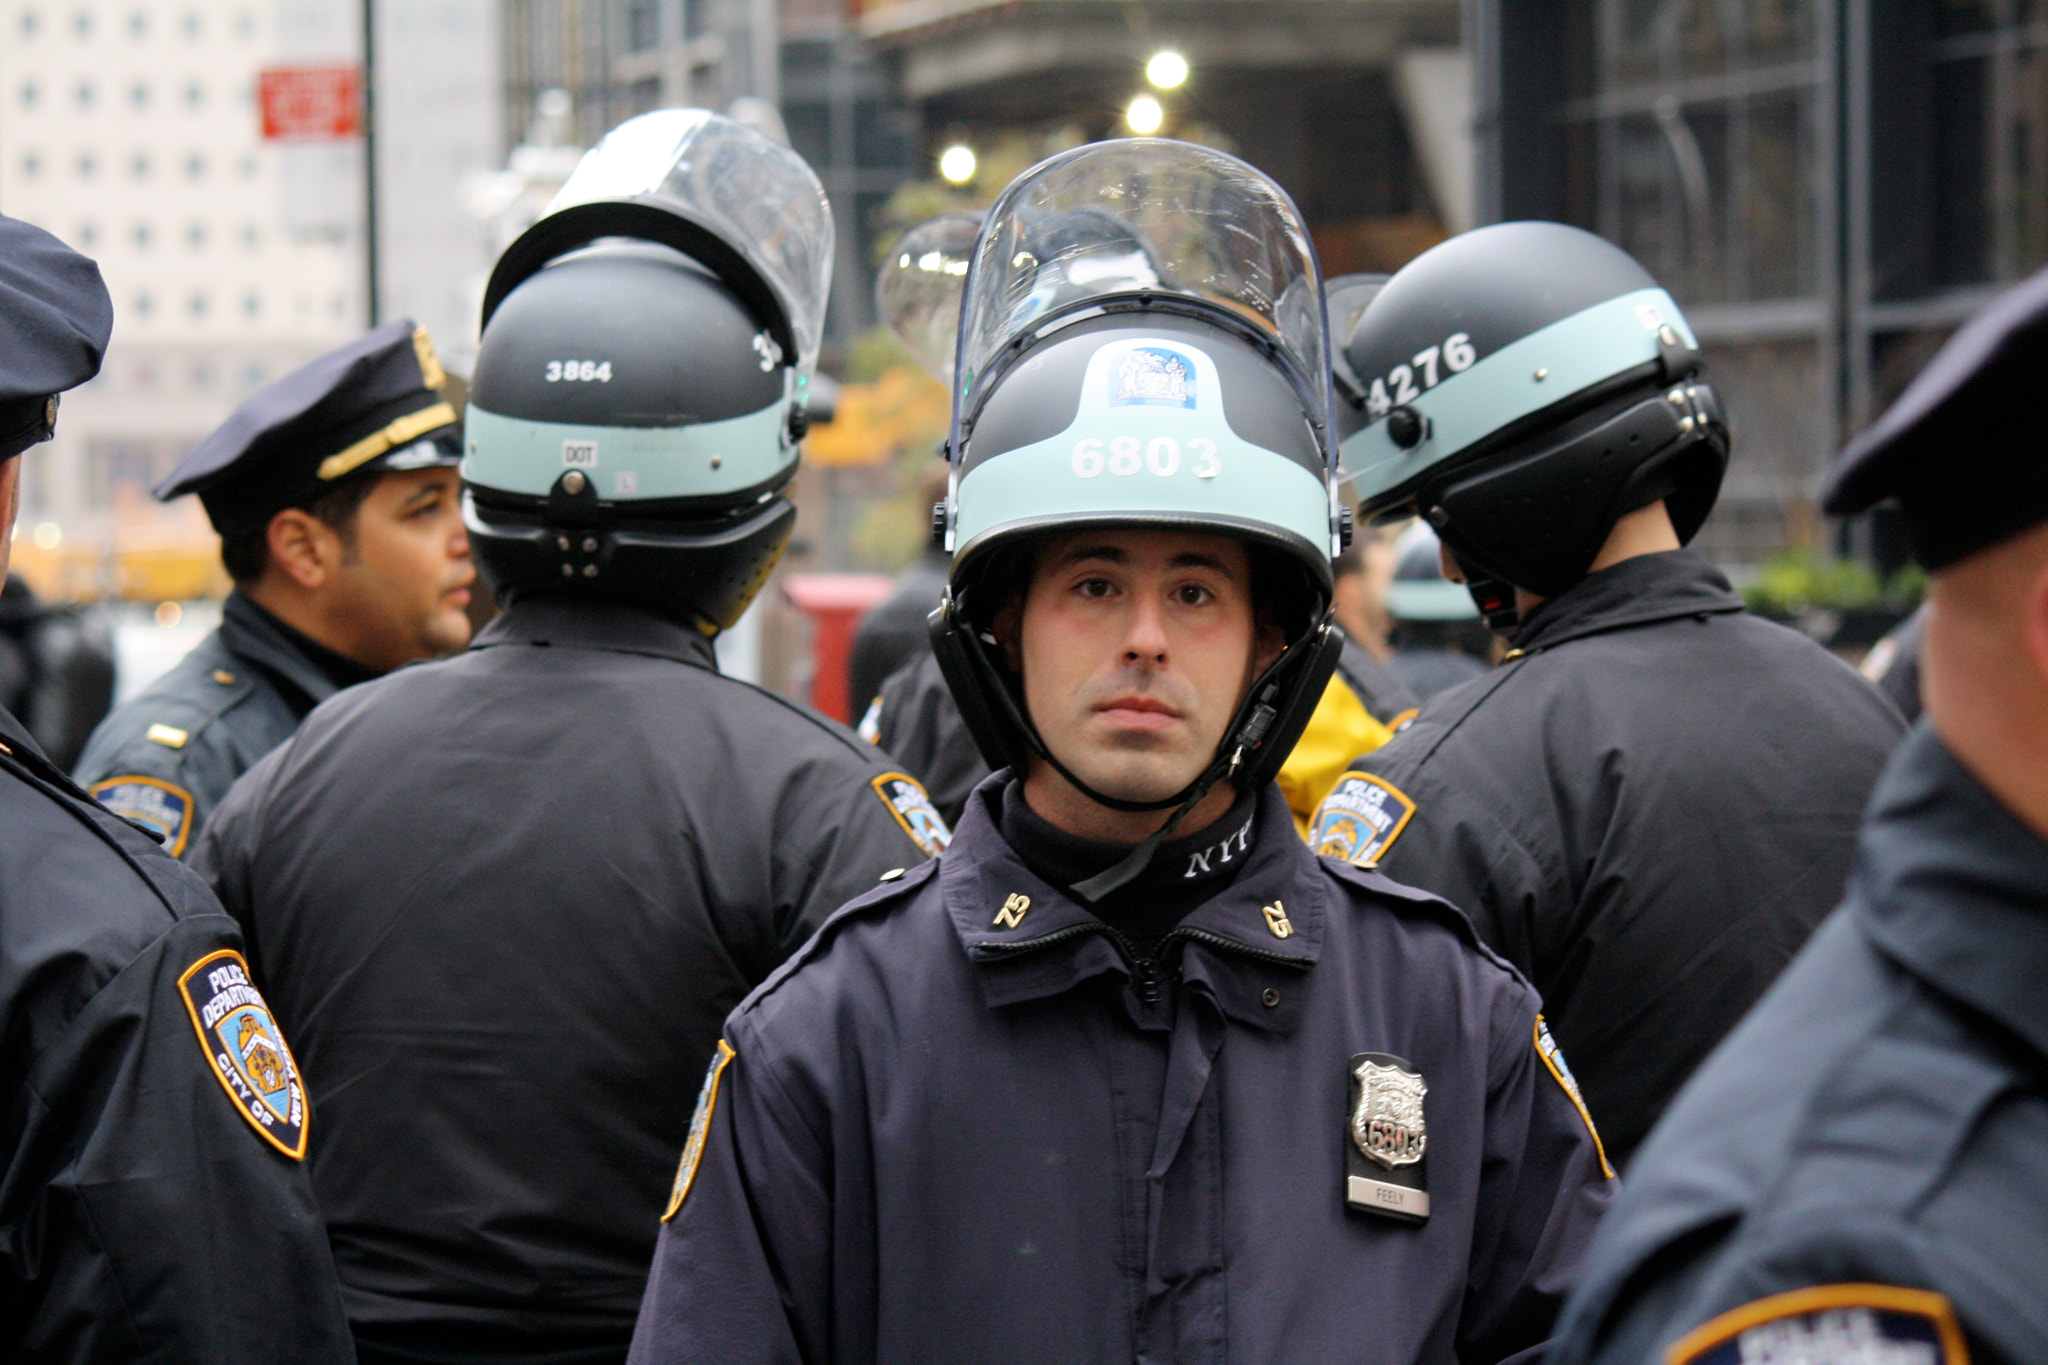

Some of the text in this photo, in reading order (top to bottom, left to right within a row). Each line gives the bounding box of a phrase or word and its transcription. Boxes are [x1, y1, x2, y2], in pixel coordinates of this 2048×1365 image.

[545, 359, 613, 382] 3864
[1365, 331, 1476, 415] 4276
[565, 446, 593, 463] DOT
[1071, 436, 1222, 480] 6803
[208, 964, 249, 994] POLICE
[217, 1053, 274, 1126] CITY OF
[290, 1082, 302, 1128] NEW
[1376, 1187, 1406, 1205] FEELY
